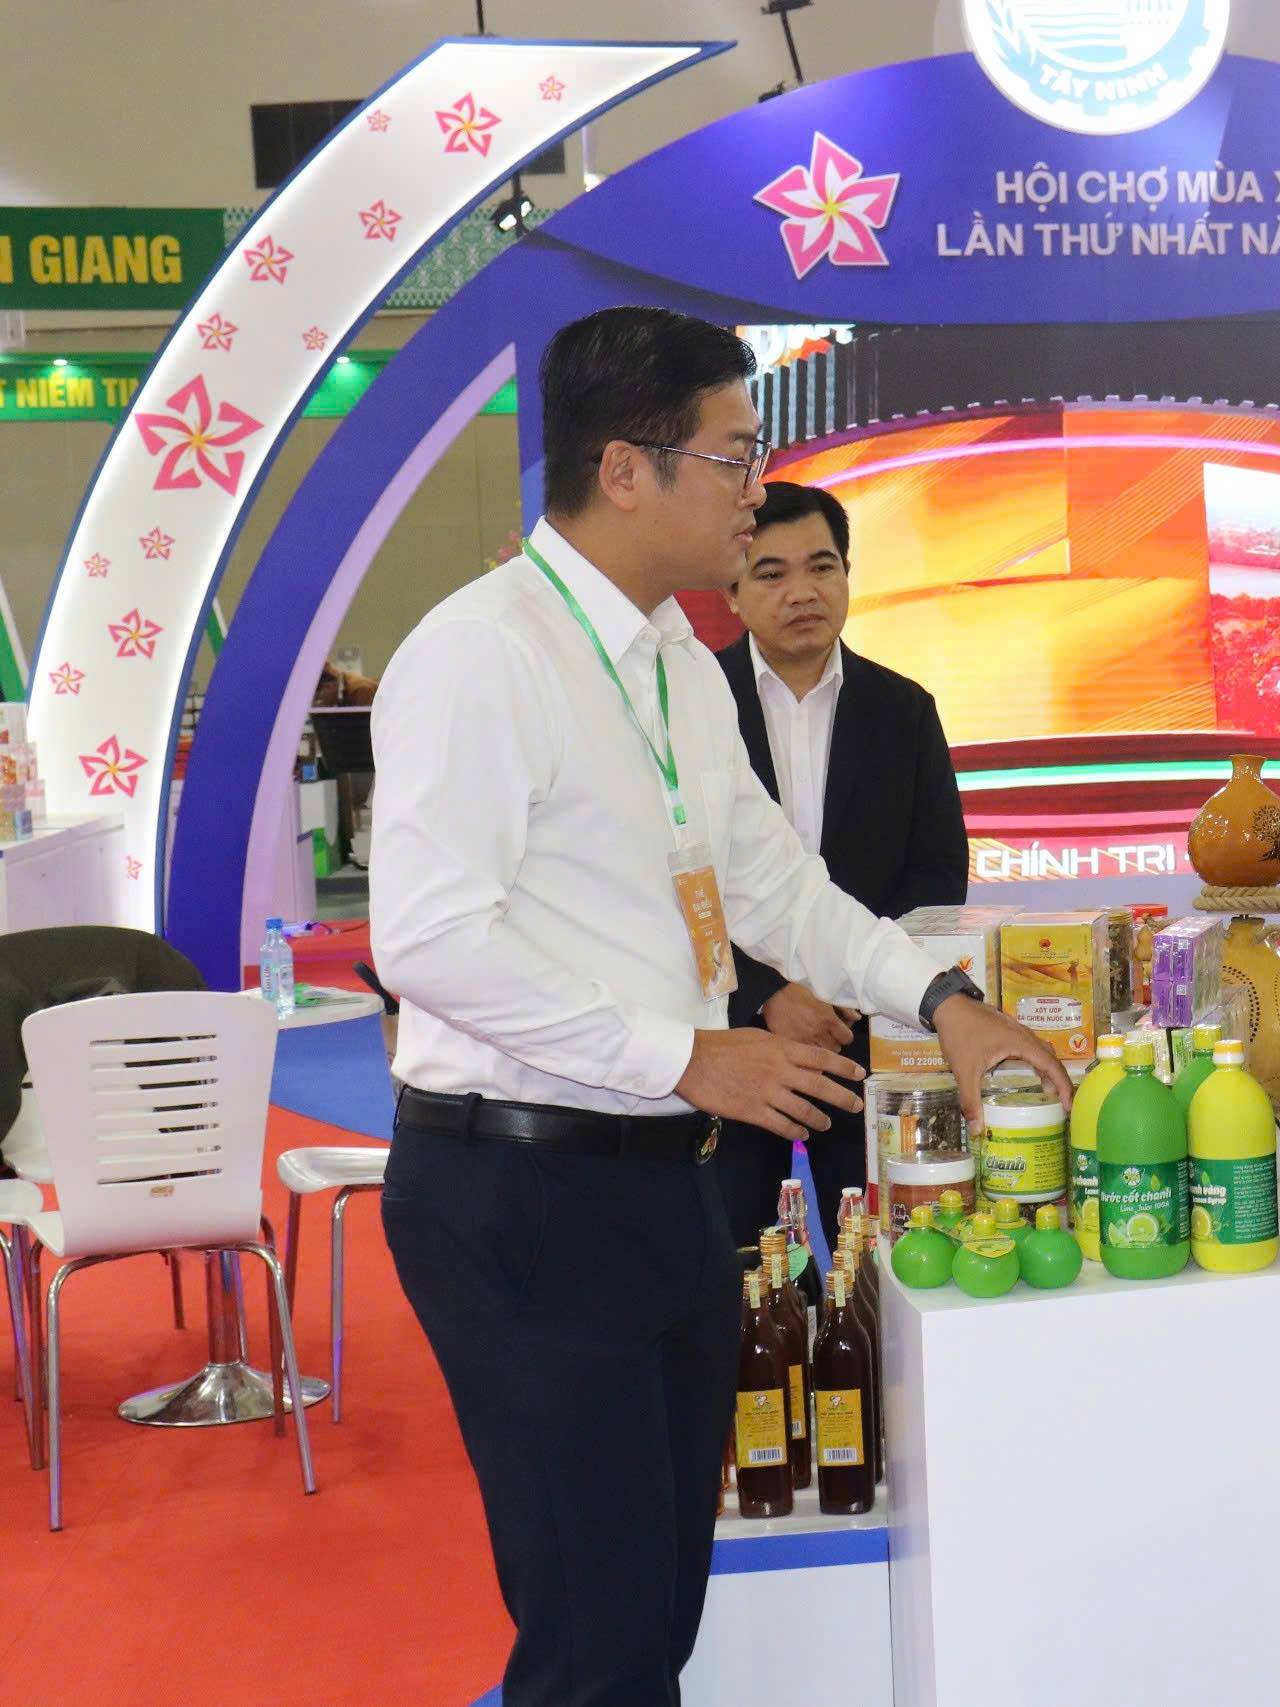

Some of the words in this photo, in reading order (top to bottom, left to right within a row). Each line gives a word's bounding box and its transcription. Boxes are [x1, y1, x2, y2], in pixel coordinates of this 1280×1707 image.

[1039, 62, 1090, 99] TÂY
[1094, 62, 1169, 101] NINH
[996, 161, 1066, 213] HỘI
[1076, 165, 1168, 213] CHỢ
[1177, 160, 1265, 204] MÙA
[937, 210, 1024, 257] LẦN
[1034, 211, 1123, 257] THỨ
[1131, 211, 1234, 256] NHẤT
[28, 234, 183, 285] GIANG
[976, 840, 1101, 877] CHÍNH
[1104, 843, 1176, 875] TRỊ
[900, 1057, 915, 1066] ISO
[1141, 1186, 1172, 1202] chanh
